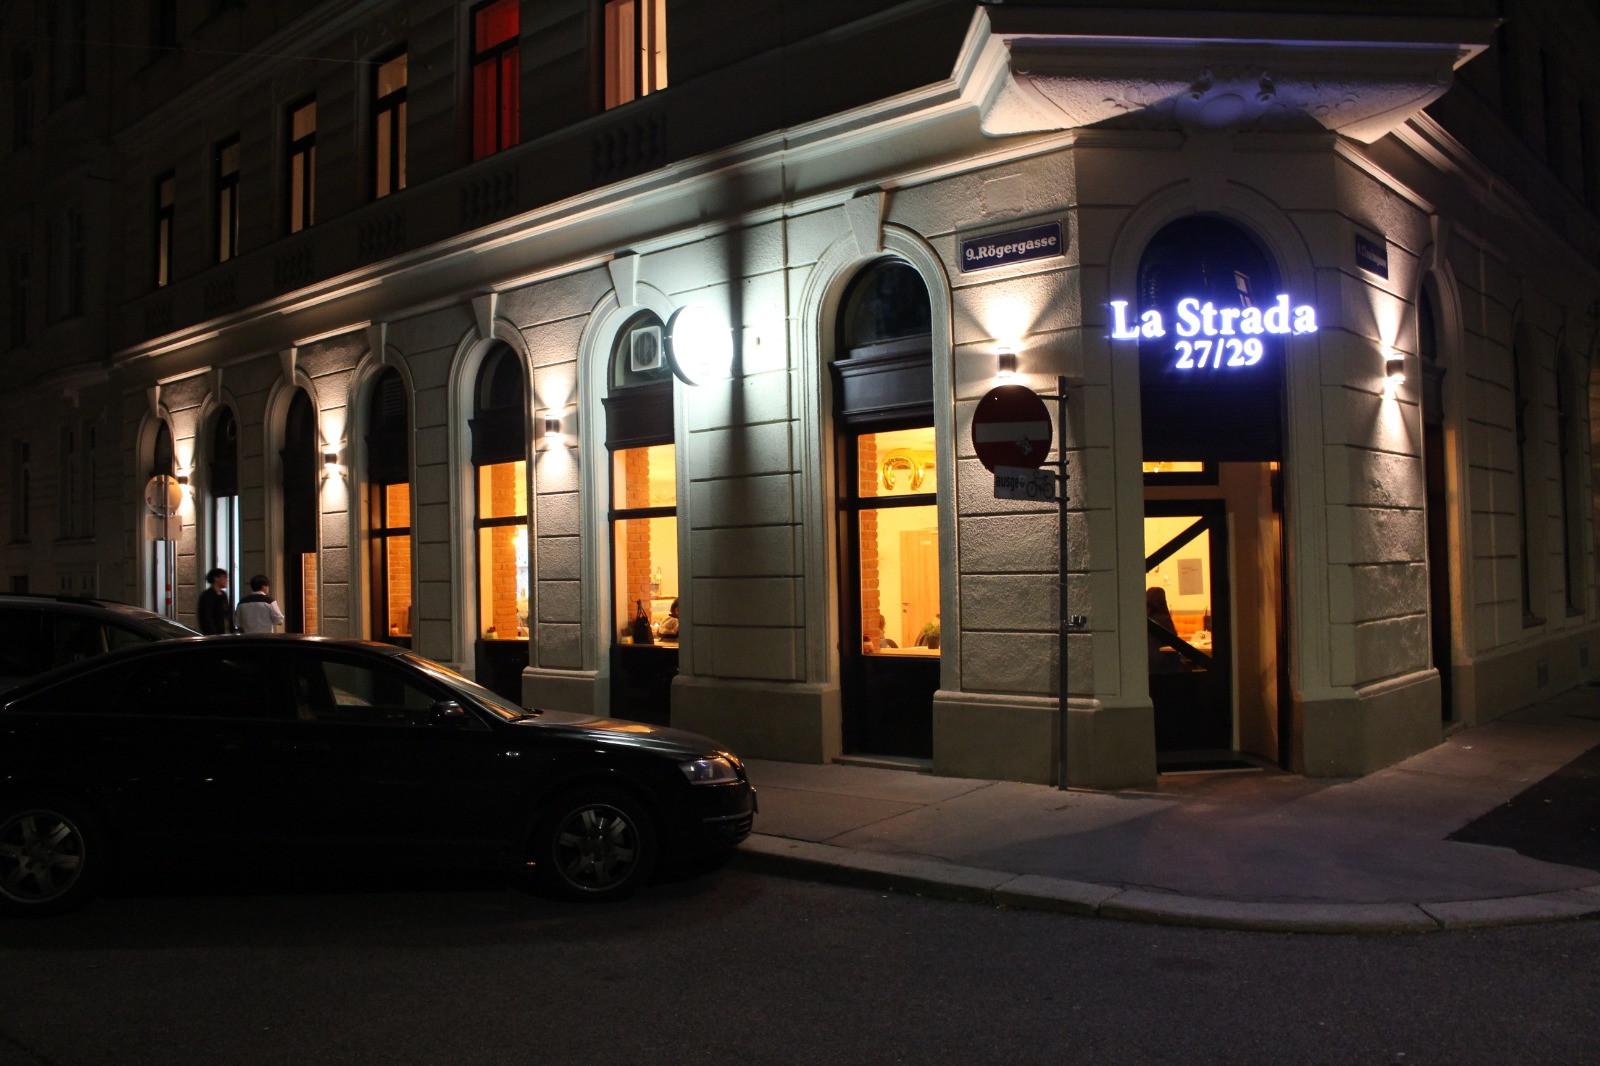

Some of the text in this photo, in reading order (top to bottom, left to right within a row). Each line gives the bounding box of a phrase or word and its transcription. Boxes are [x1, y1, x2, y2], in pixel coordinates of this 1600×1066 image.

[1110, 294, 1319, 340] La Strada
[1174, 338, 1264, 369] 27/29
